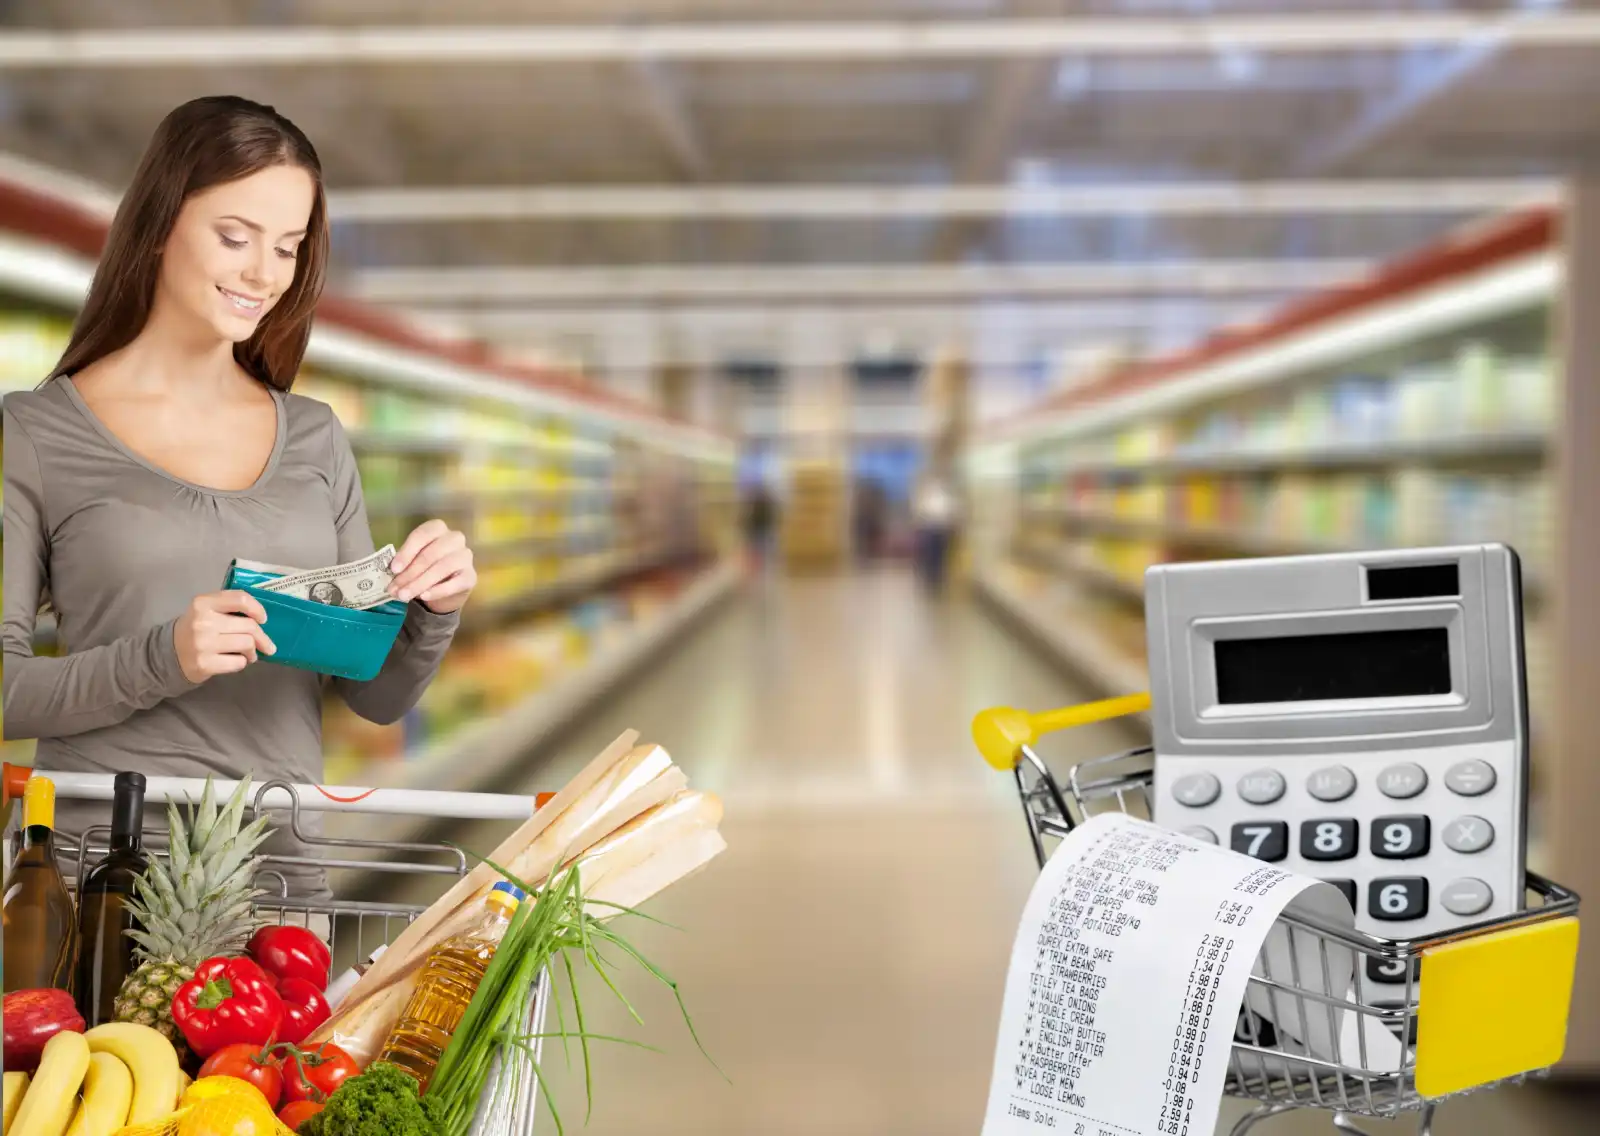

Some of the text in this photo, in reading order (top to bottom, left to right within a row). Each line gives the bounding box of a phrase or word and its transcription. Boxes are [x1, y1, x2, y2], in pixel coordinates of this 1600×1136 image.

[1243, 827, 1271, 856] 7
[1314, 823, 1342, 851] 8
[1383, 823, 1412, 852] 9
[1074, 889, 1091, 902] RED
[1092, 894, 1123, 910] GRAPES
[1117, 888, 1134, 900] AND
[1136, 893, 1158, 906] HERB
[1214, 911, 1237, 925] 1.39
[1236, 916, 1246, 927] D
[1219, 900, 1243, 913] 0.54
[1243, 905, 1253, 915] D
[1379, 884, 1408, 913] 6
[1037, 933, 1220, 989] DUREX EXTRA SAFE 5.98 B
[1041, 922, 1224, 976] HORLICKS 1.34 D
[1082, 917, 1122, 936] POTATOES
[1197, 946, 1219, 960] 0.99
[1221, 952, 1229, 963] D
[1201, 933, 1225, 948] 2.59
[1225, 939, 1234, 950] D
[1030, 972, 1210, 1030] TETLEY TEA BAGS 1.89 D
[1050, 964, 1106, 989] STRAWBERRIES
[1183, 998, 1203, 1014] 1.88
[1206, 1004, 1213, 1016] D
[1071, 955, 1096, 972] BEANS
[1186, 985, 1206, 1000] 1.29
[1208, 990, 1216, 1002] D
[1068, 996, 1097, 1014] ONIONS
[1176, 1025, 1197, 1041] 0.99
[1200, 1031, 1207, 1043] D
[1070, 1011, 1095, 1027] CREAM
[1173, 1038, 1194, 1054] 0.56
[1197, 1045, 1204, 1057] D
[1039, 1030, 1072, 1049] ENGLISH
[1075, 1040, 1104, 1057] BUTTER
[1168, 1065, 1188, 1081] 0.94
[1192, 1071, 1199, 1083] D
[1040, 1017, 1074, 1035] ENGLISH
[1077, 1026, 1107, 1043] BUTTER
[1170, 1052, 1191, 1067] 0.94
[1195, 1058, 1202, 1070] D
[1015, 1064, 1190, 1124] NIVEA FOR MEN 2.59 A
[1068, 1051, 1092, 1068] Offer
[1162, 1079, 1186, 1095] -0.08
[1008, 1103, 1031, 1120] Items
[1034, 1111, 1057, 1128] Sold:
[1074, 1122, 1085, 1136] 20
[1030, 1082, 1055, 1099] LOOSE
[1057, 1090, 1086, 1108] LEMONS
[1158, 1119, 1178, 1135] 0.28
[1181, 1126, 1188, 1136] D
[1165, 1092, 1184, 1108] 1.98
[1186, 1098, 1193, 1110] D
